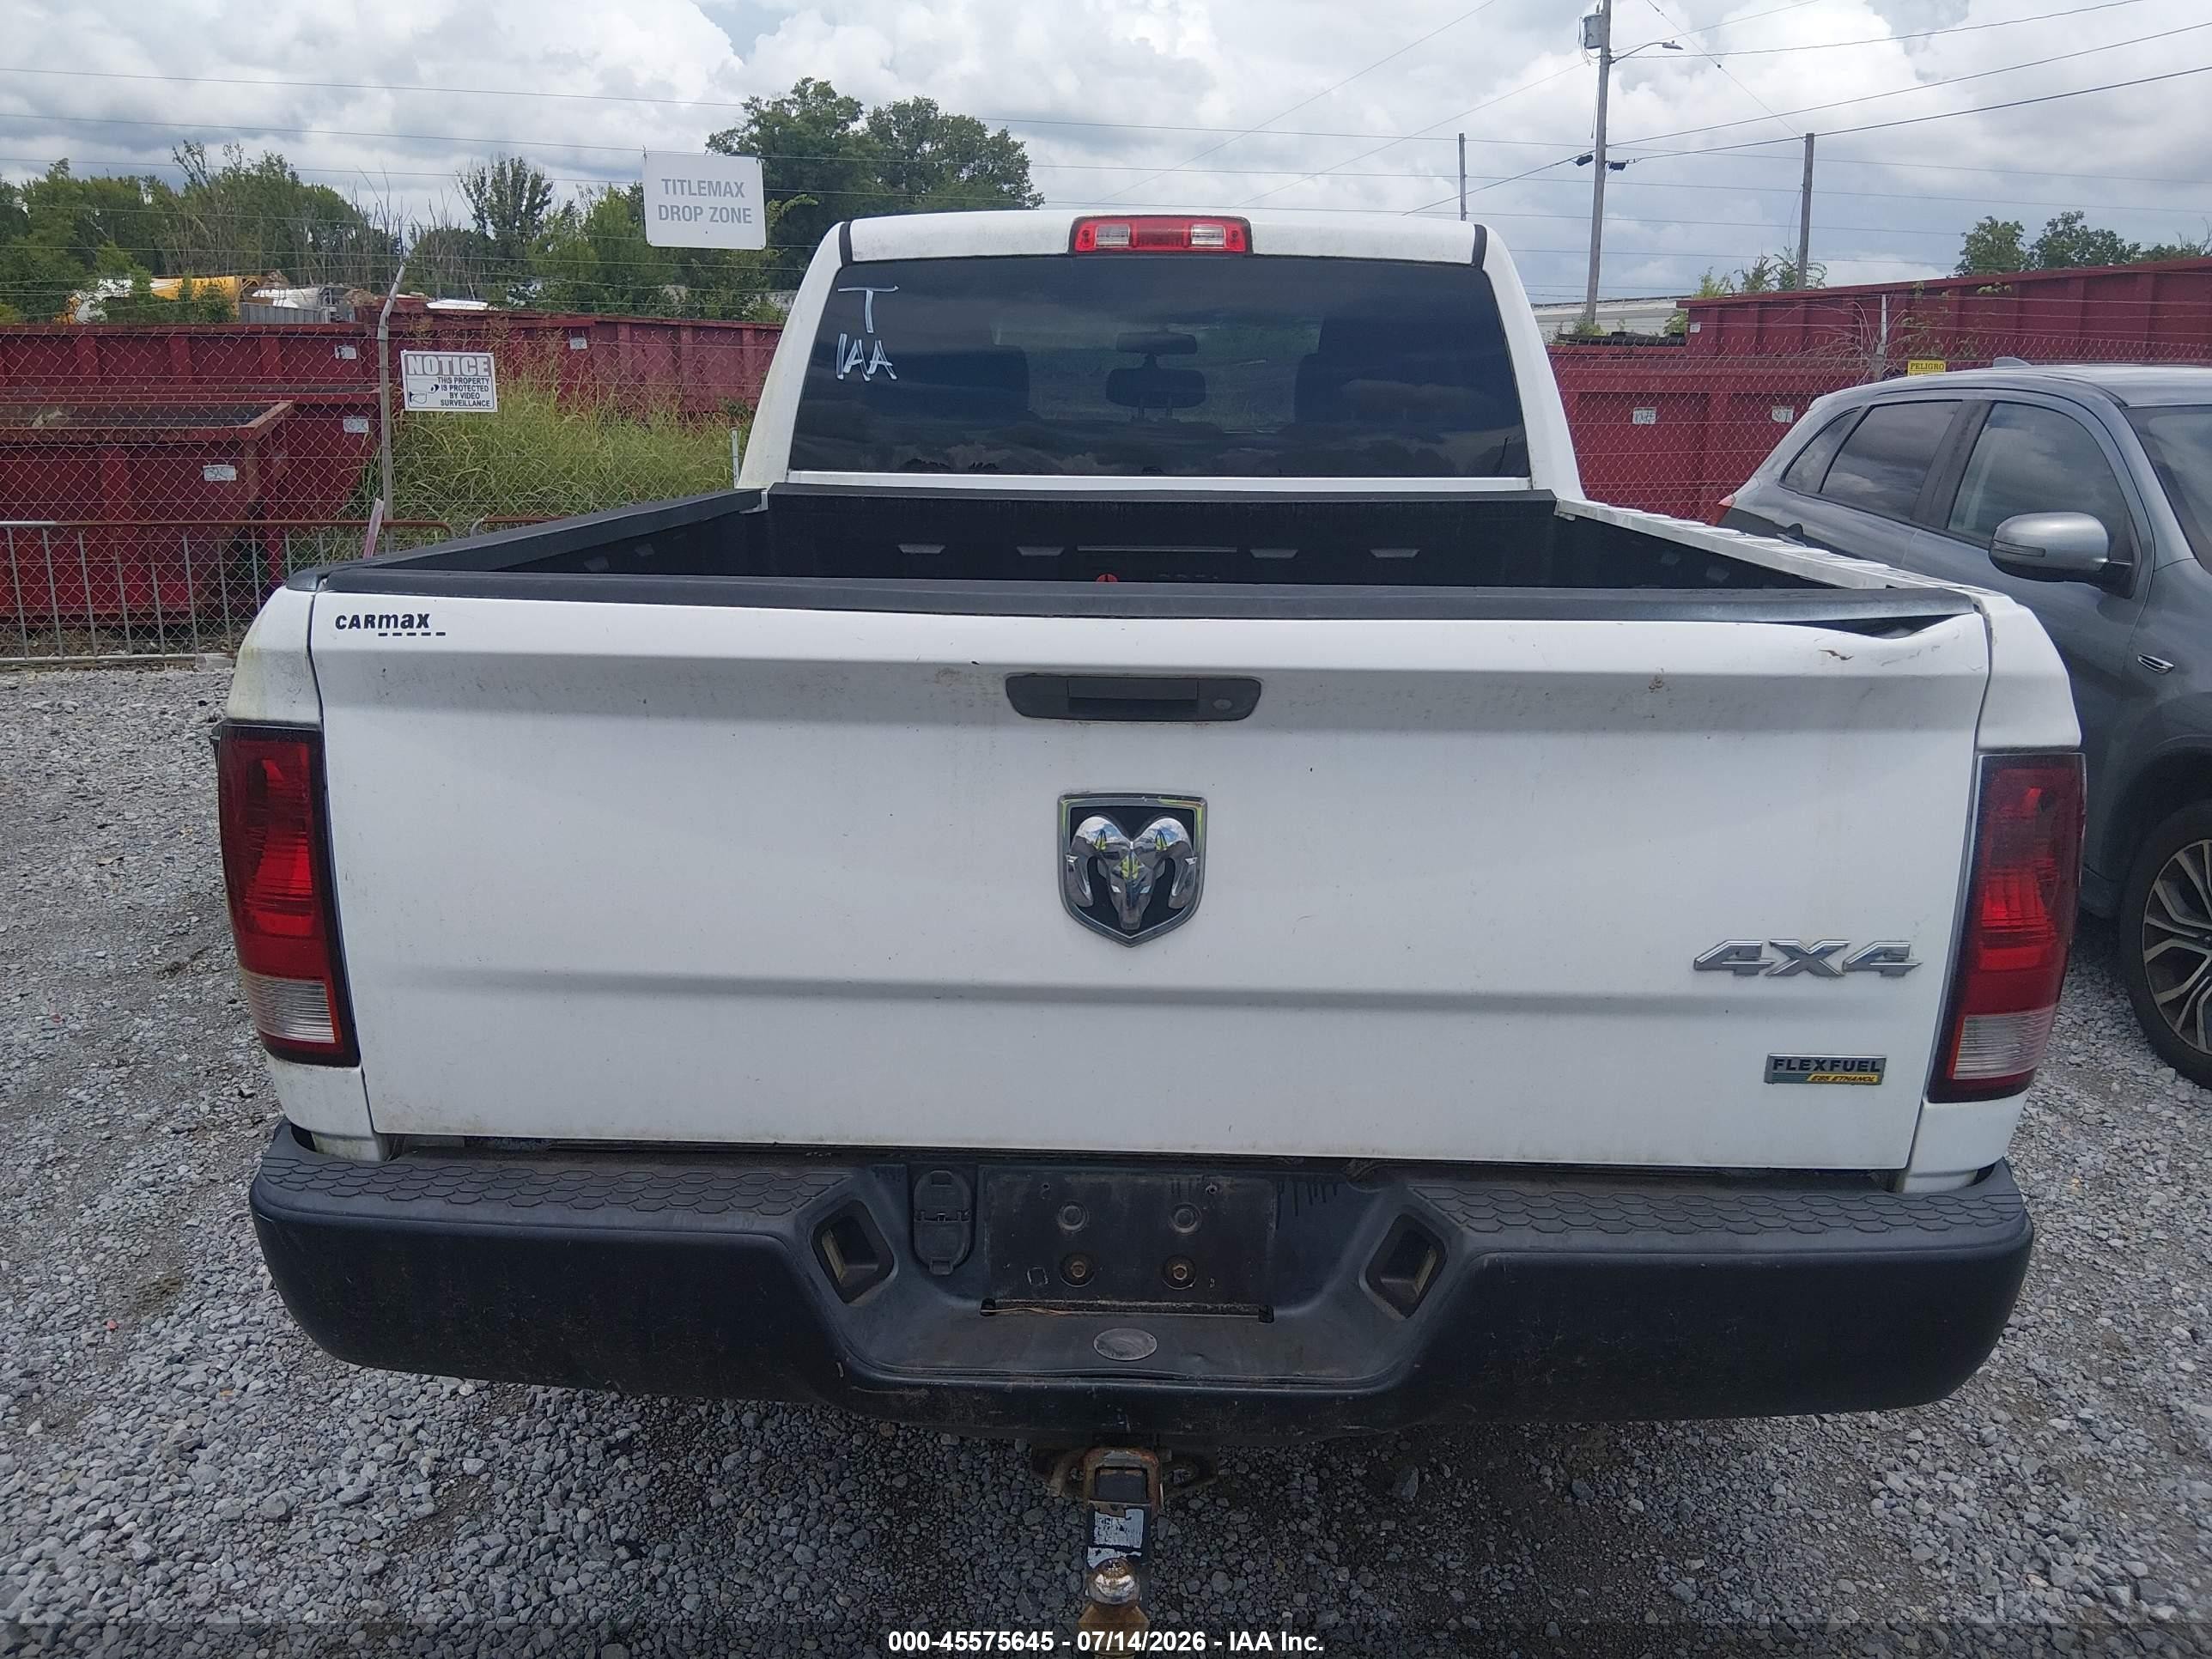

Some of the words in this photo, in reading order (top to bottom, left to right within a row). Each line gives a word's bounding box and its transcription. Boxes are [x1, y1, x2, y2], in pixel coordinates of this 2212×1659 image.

[661, 179, 745, 198] TITLEMAX
[658, 204, 704, 222] DROP
[708, 206, 753, 224] ZONE
[837, 285, 899, 333] T
[407, 356, 490, 376] NOTICE
[836, 333, 898, 381] IAA
[1910, 362, 1945, 371] PELIGRO
[449, 384, 489, 392] PROTECTED
[460, 392, 481, 400] VIDEO
[1772, 1058, 1881, 1073] FLEXFUEL
